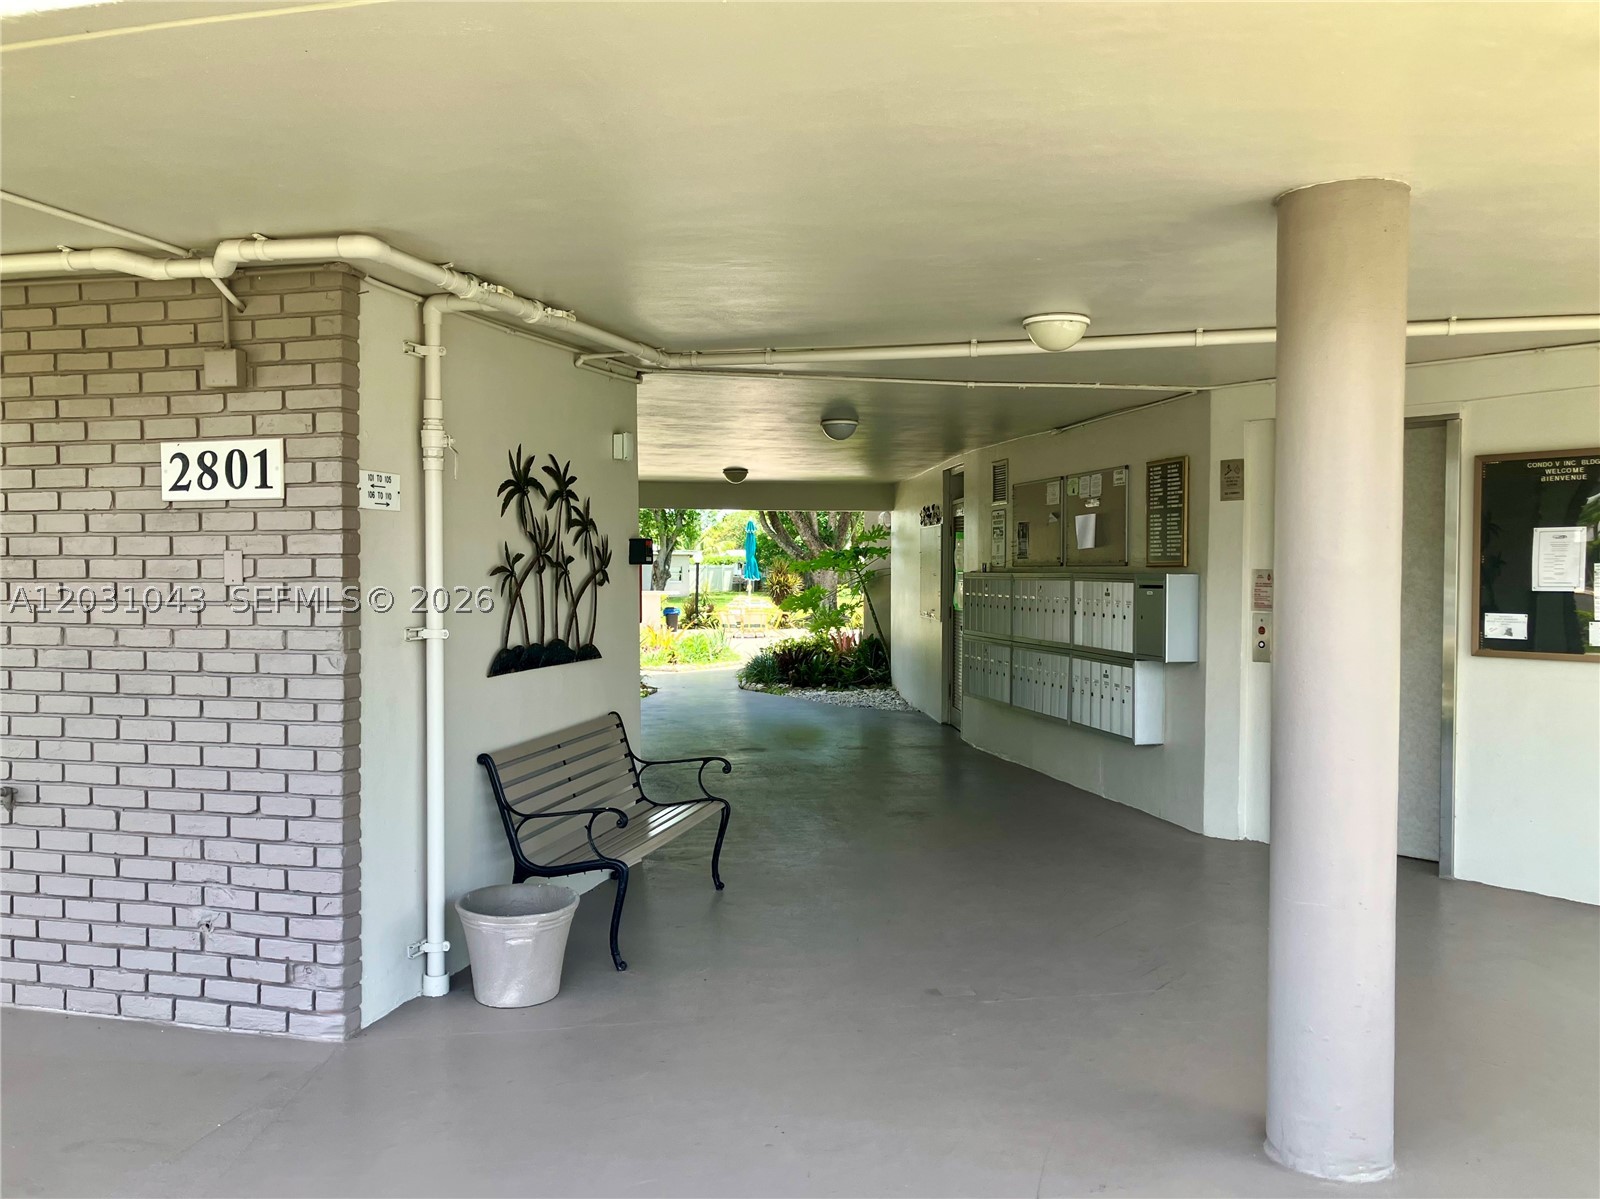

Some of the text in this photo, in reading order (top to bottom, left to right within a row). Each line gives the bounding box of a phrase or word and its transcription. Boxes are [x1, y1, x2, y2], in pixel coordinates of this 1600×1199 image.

[168, 448, 273, 492] 2801
[376, 474, 382, 482] TO
[1541, 474, 1587, 482] BIENVENUE
[377, 491, 383, 499] TO
